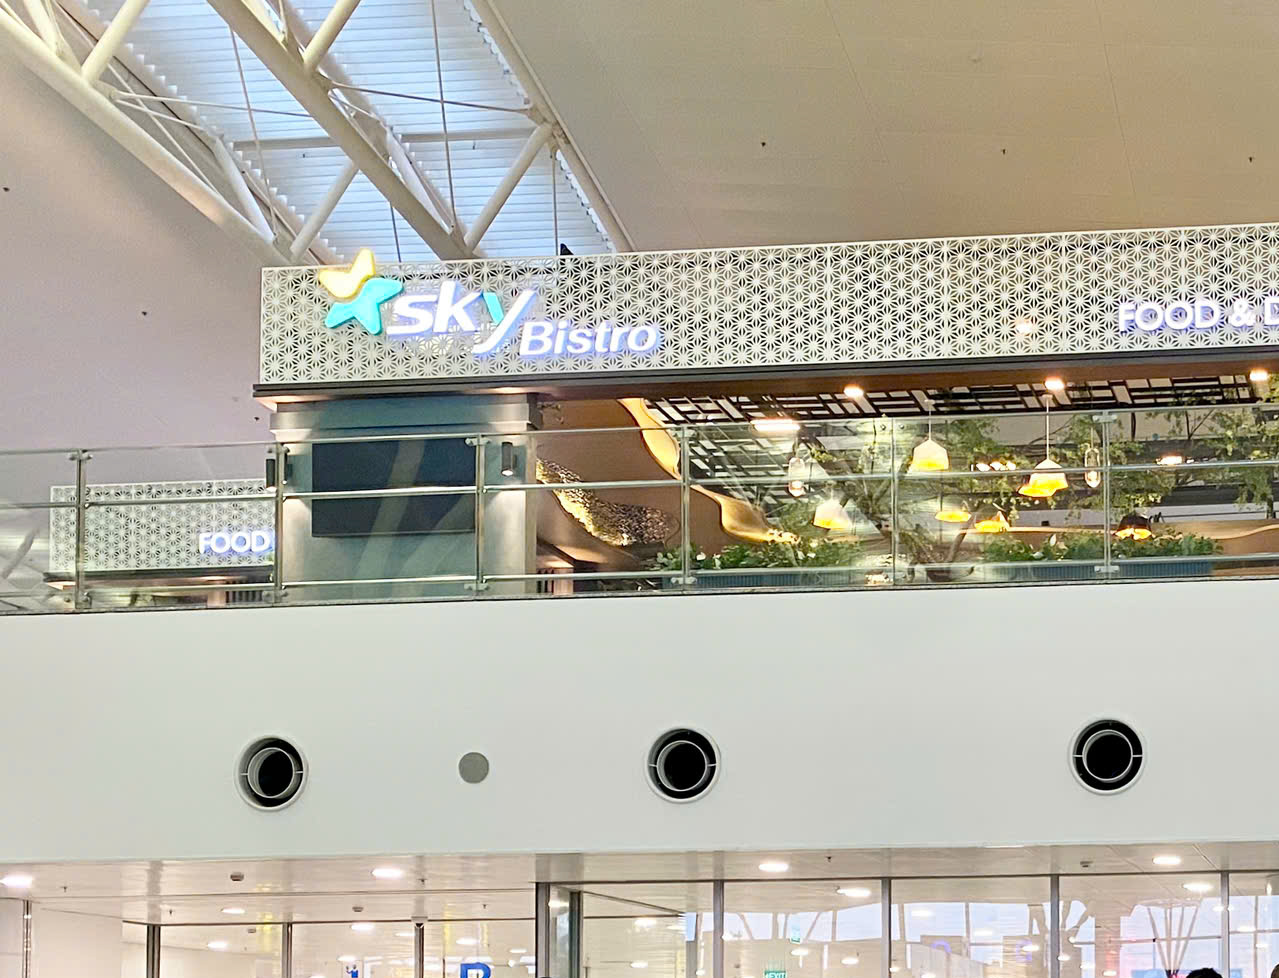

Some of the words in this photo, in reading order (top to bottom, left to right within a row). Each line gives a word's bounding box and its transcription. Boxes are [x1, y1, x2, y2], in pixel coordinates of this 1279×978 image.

[1117, 299, 1222, 332] FOOD
[1227, 298, 1256, 328] &
[518, 319, 660, 357] Bistro
[199, 530, 270, 554] FOOD
